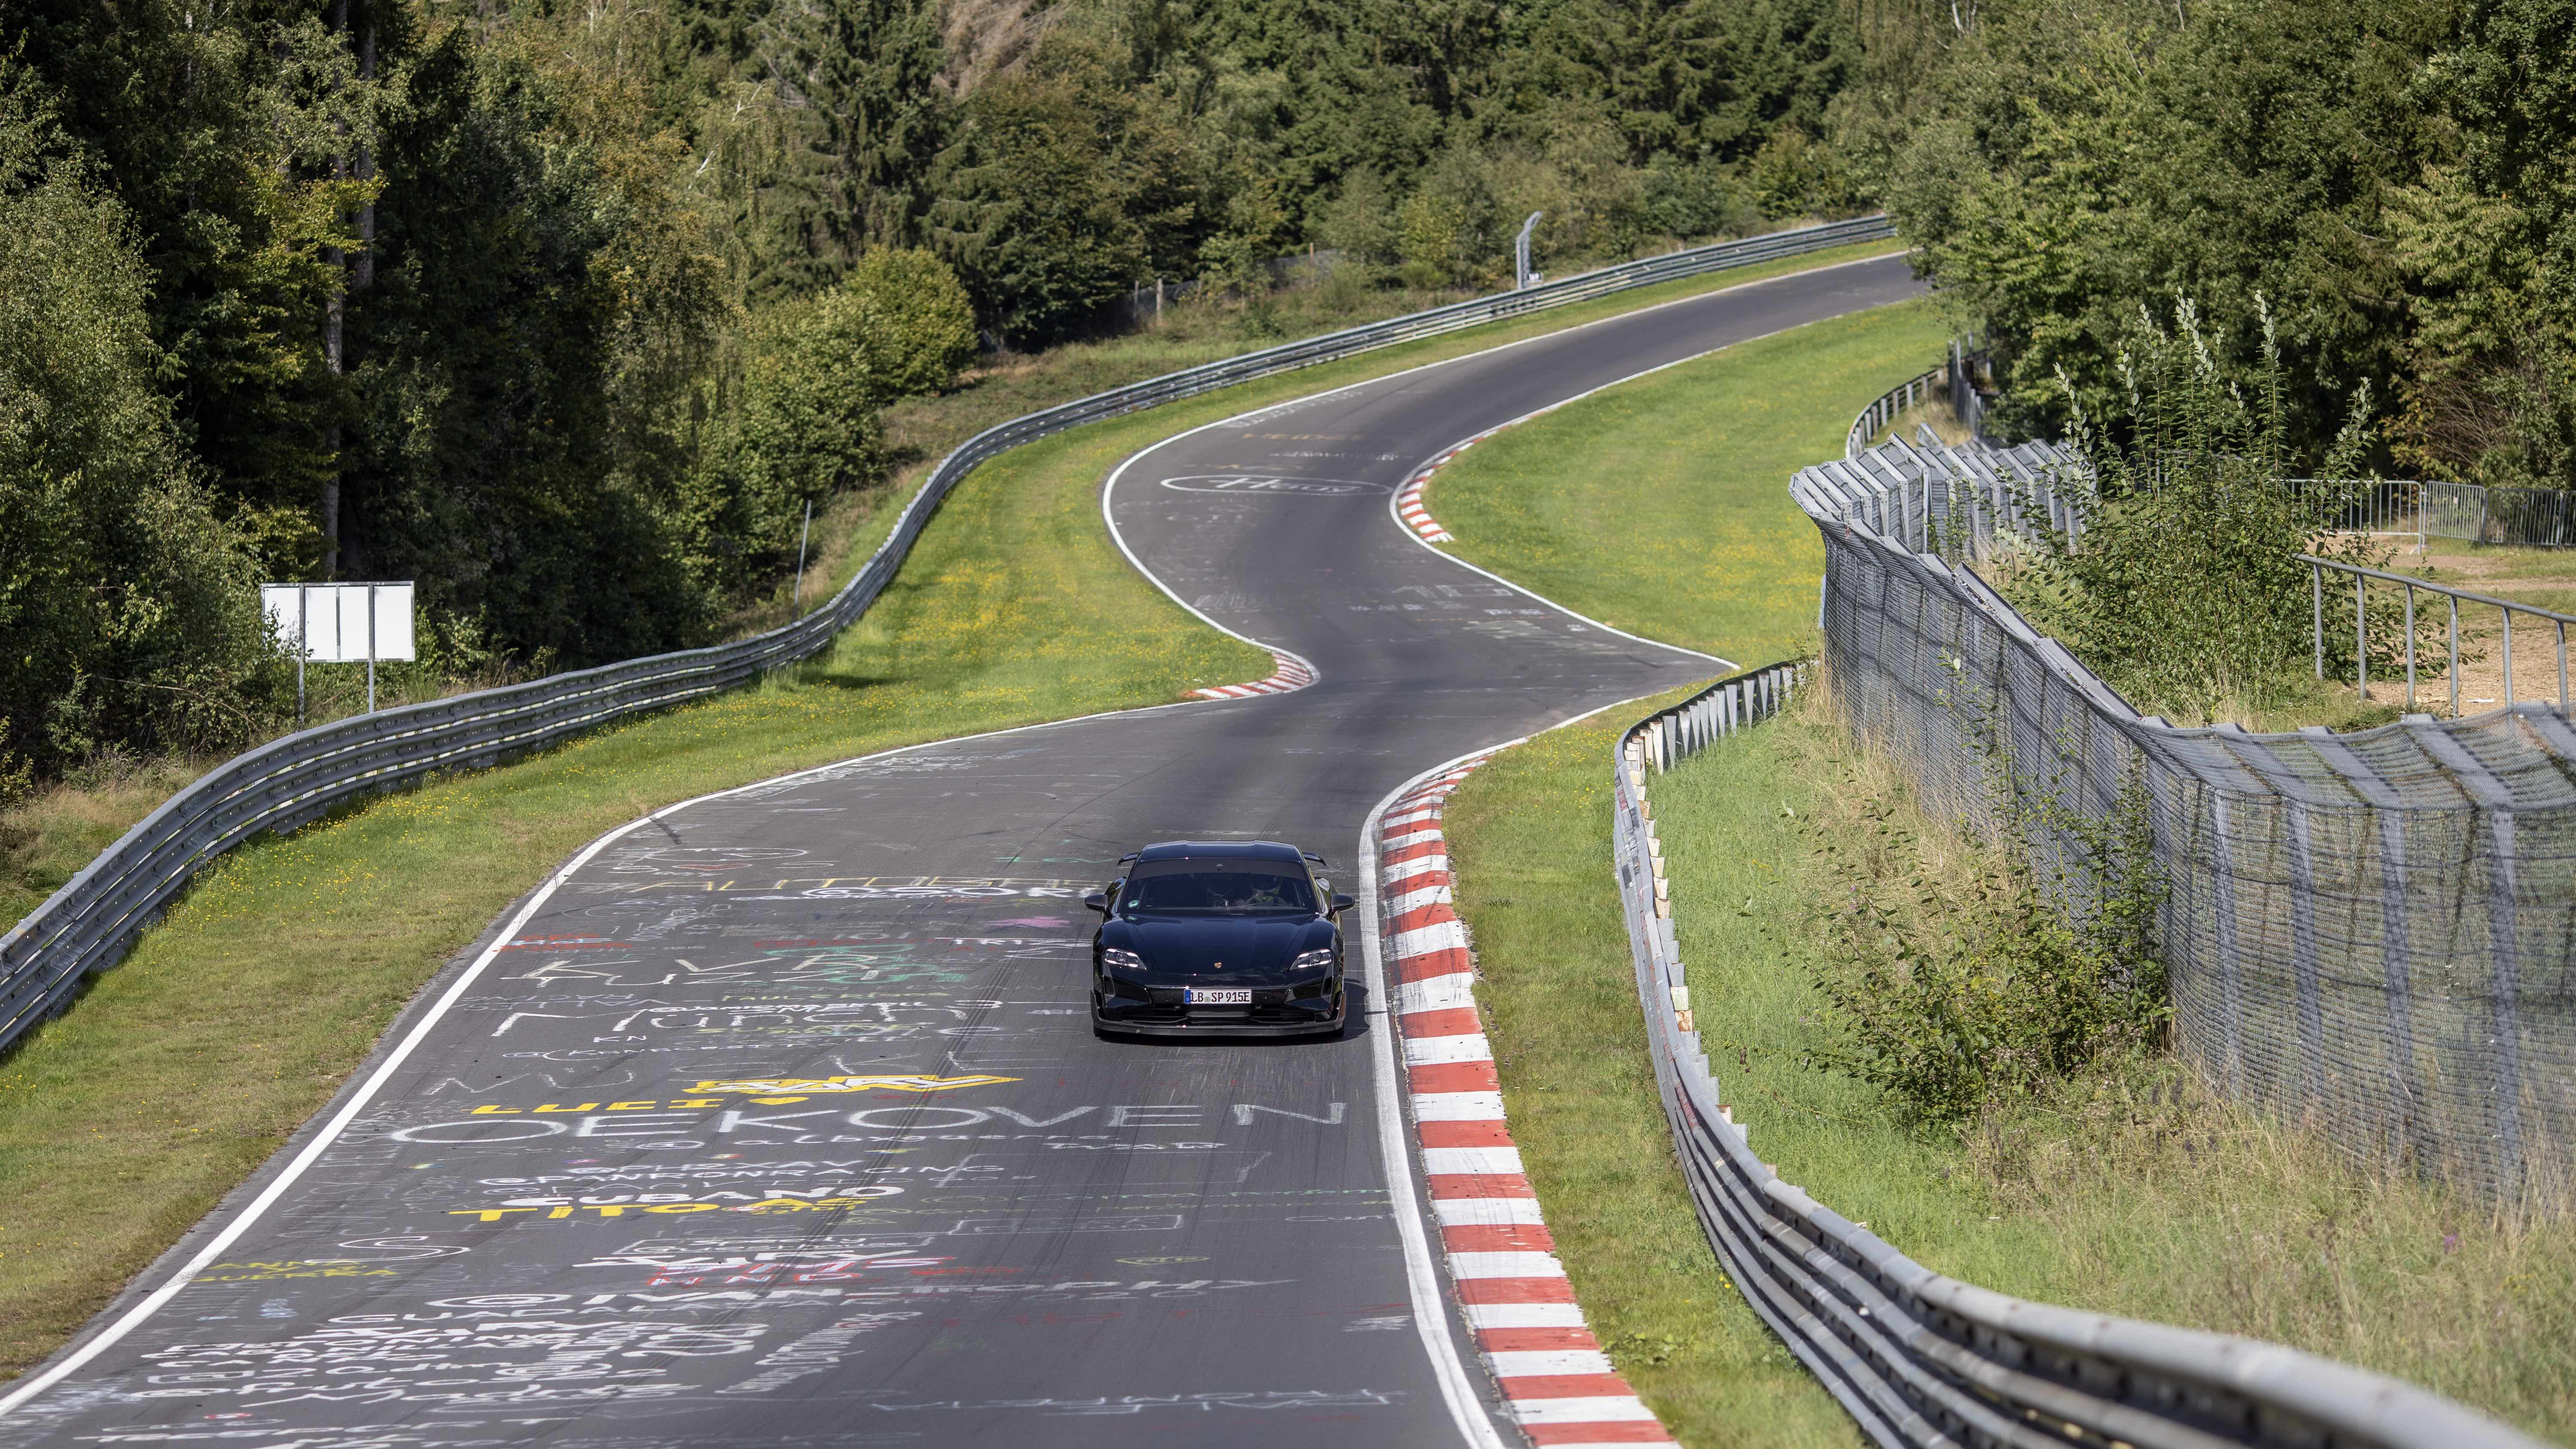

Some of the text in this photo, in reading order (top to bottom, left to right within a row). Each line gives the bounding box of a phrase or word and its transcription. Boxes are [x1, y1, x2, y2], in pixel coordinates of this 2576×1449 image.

[1191, 992, 1250, 1002] LB SP 915E
